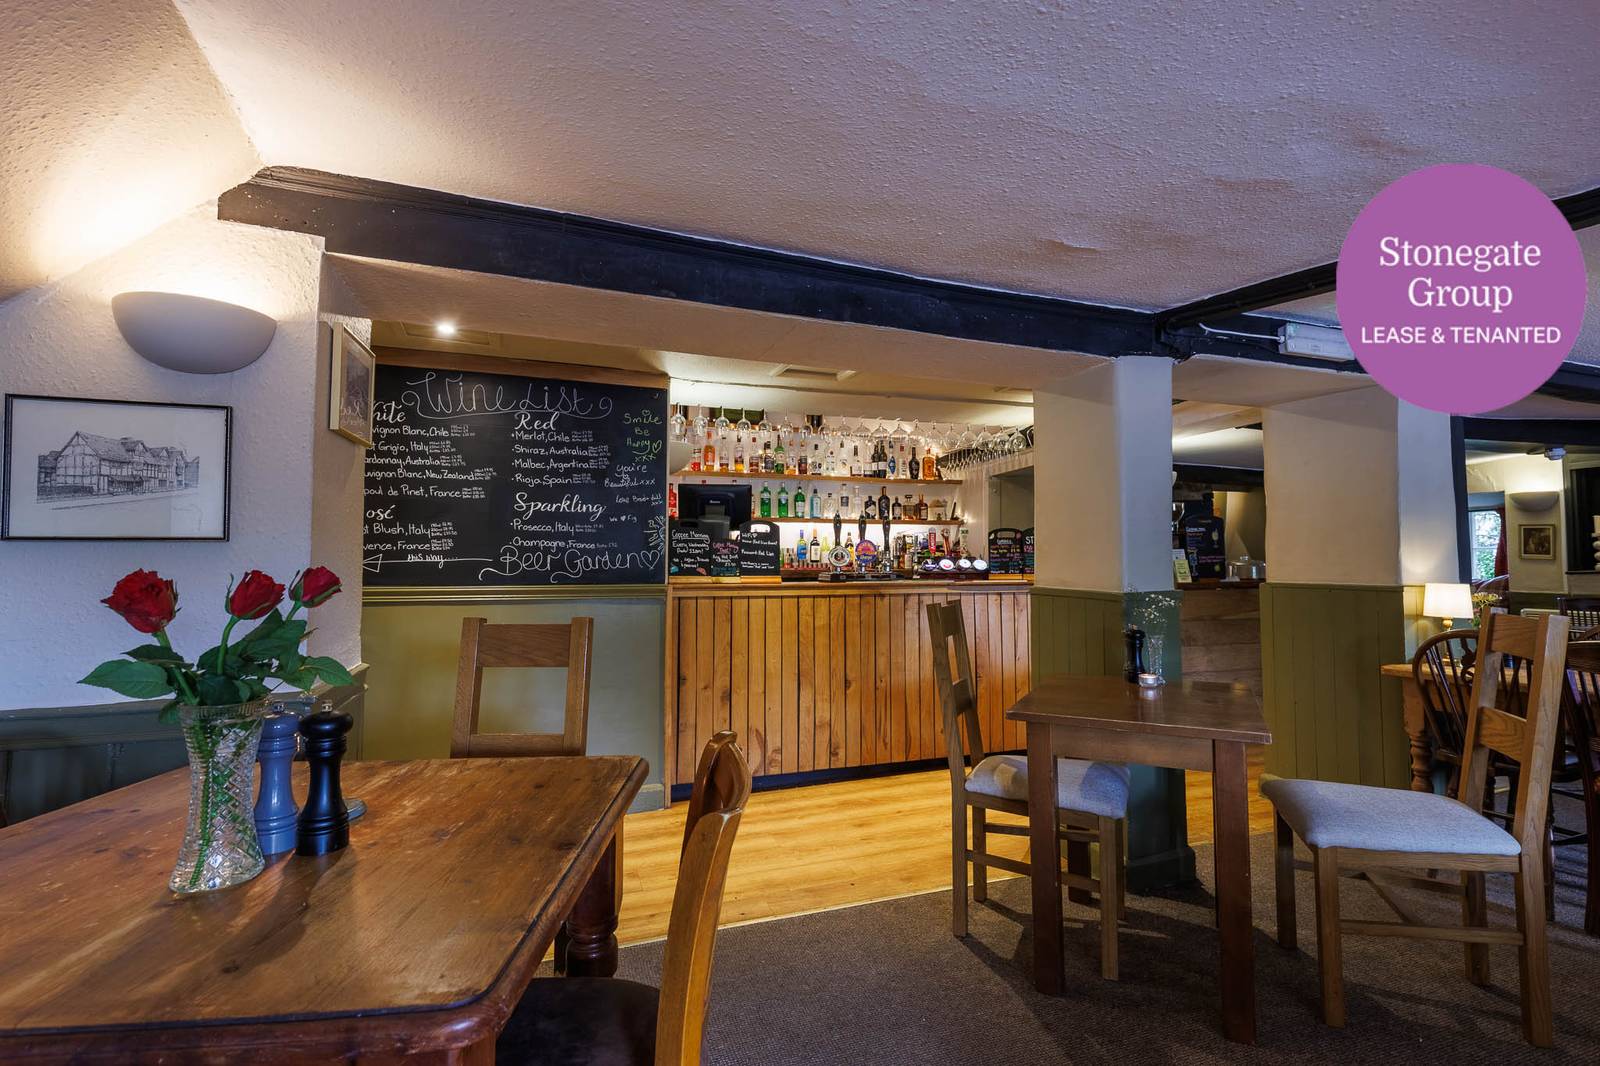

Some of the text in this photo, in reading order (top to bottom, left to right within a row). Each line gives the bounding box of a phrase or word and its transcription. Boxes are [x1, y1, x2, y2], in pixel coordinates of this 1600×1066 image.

[406, 371, 516, 413] Wine
[372, 400, 406, 424] hite
[623, 411, 663, 425] Smile
[514, 412, 560, 430] Red
[634, 426, 650, 436] Be
[410, 441, 429, 454] Italy
[550, 446, 589, 456] Australia
[405, 455, 440, 466] Australia
[441, 469, 474, 481] Zealand
[387, 486, 399, 496] de
[429, 485, 461, 498] France
[366, 504, 396, 521] osé
[513, 491, 606, 521] Sparkling
[408, 523, 431, 539] Italy
[554, 520, 575, 536] Italy
[397, 540, 430, 551] France
[568, 540, 596, 549] France
[479, 545, 645, 583] Beer Garden
